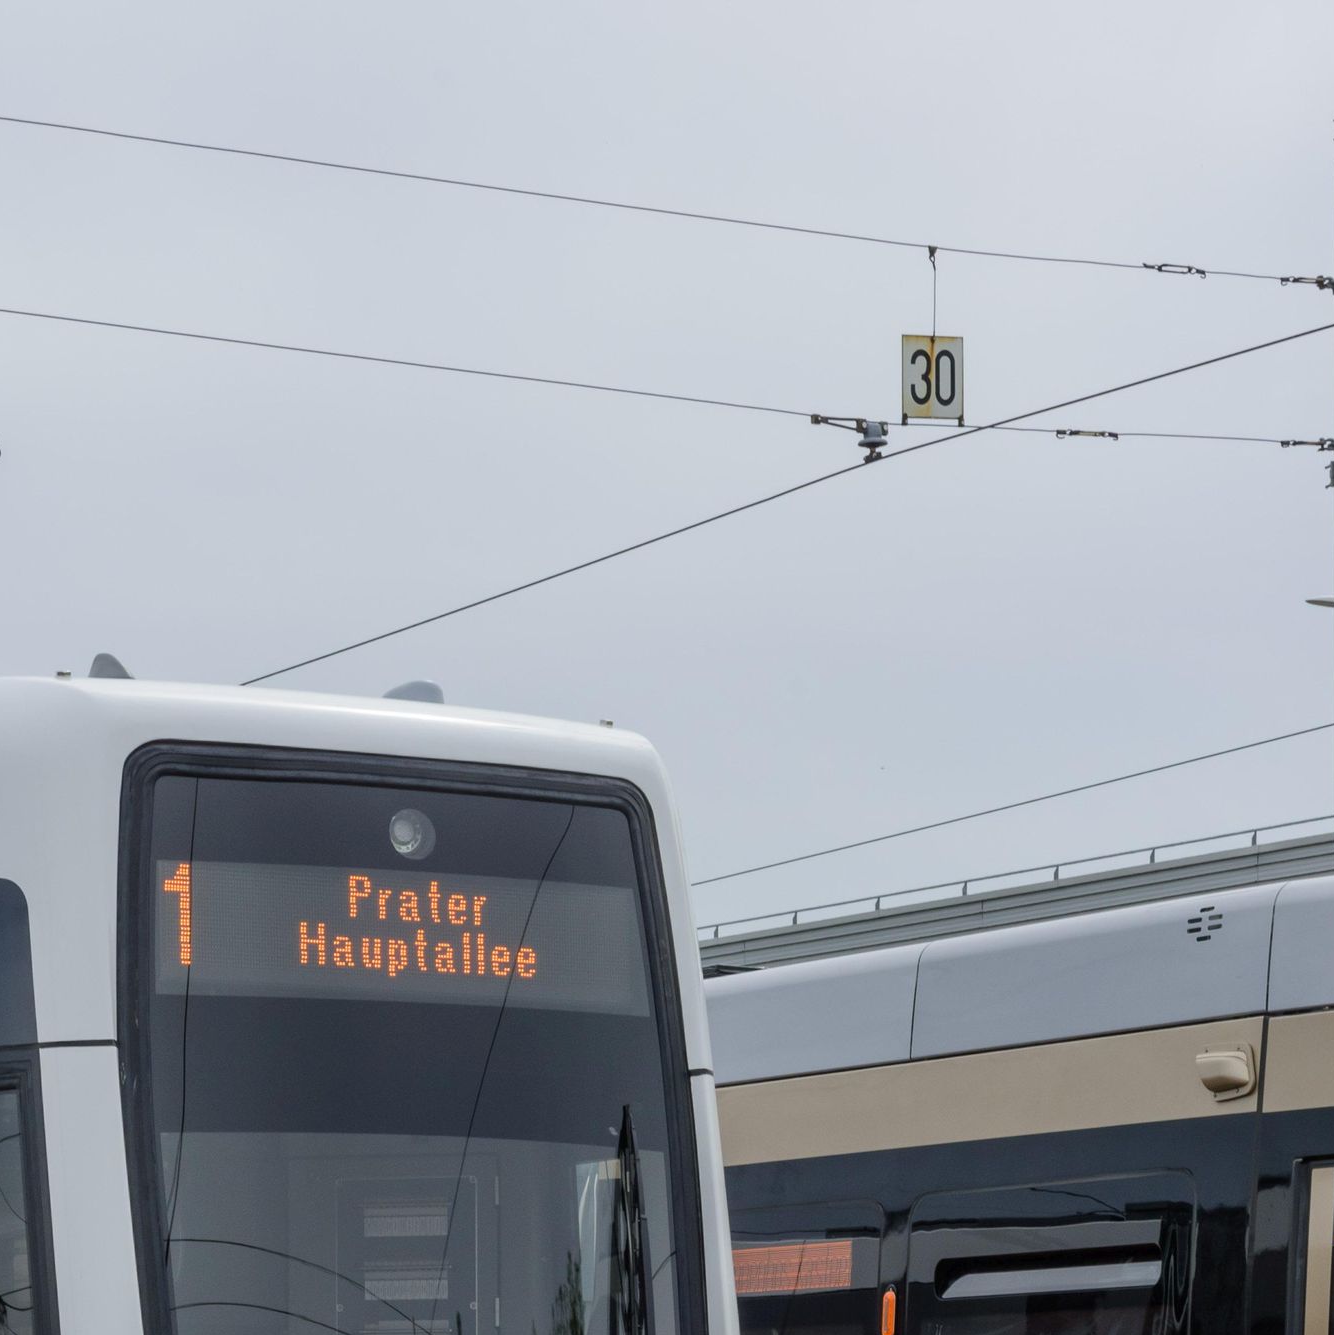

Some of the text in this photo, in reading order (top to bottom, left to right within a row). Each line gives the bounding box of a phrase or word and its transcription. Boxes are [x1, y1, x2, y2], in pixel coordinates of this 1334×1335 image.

[910, 349, 956, 407] 30
[164, 863, 487, 965] 1 Prater
[299, 921, 537, 977] Hauptallee
